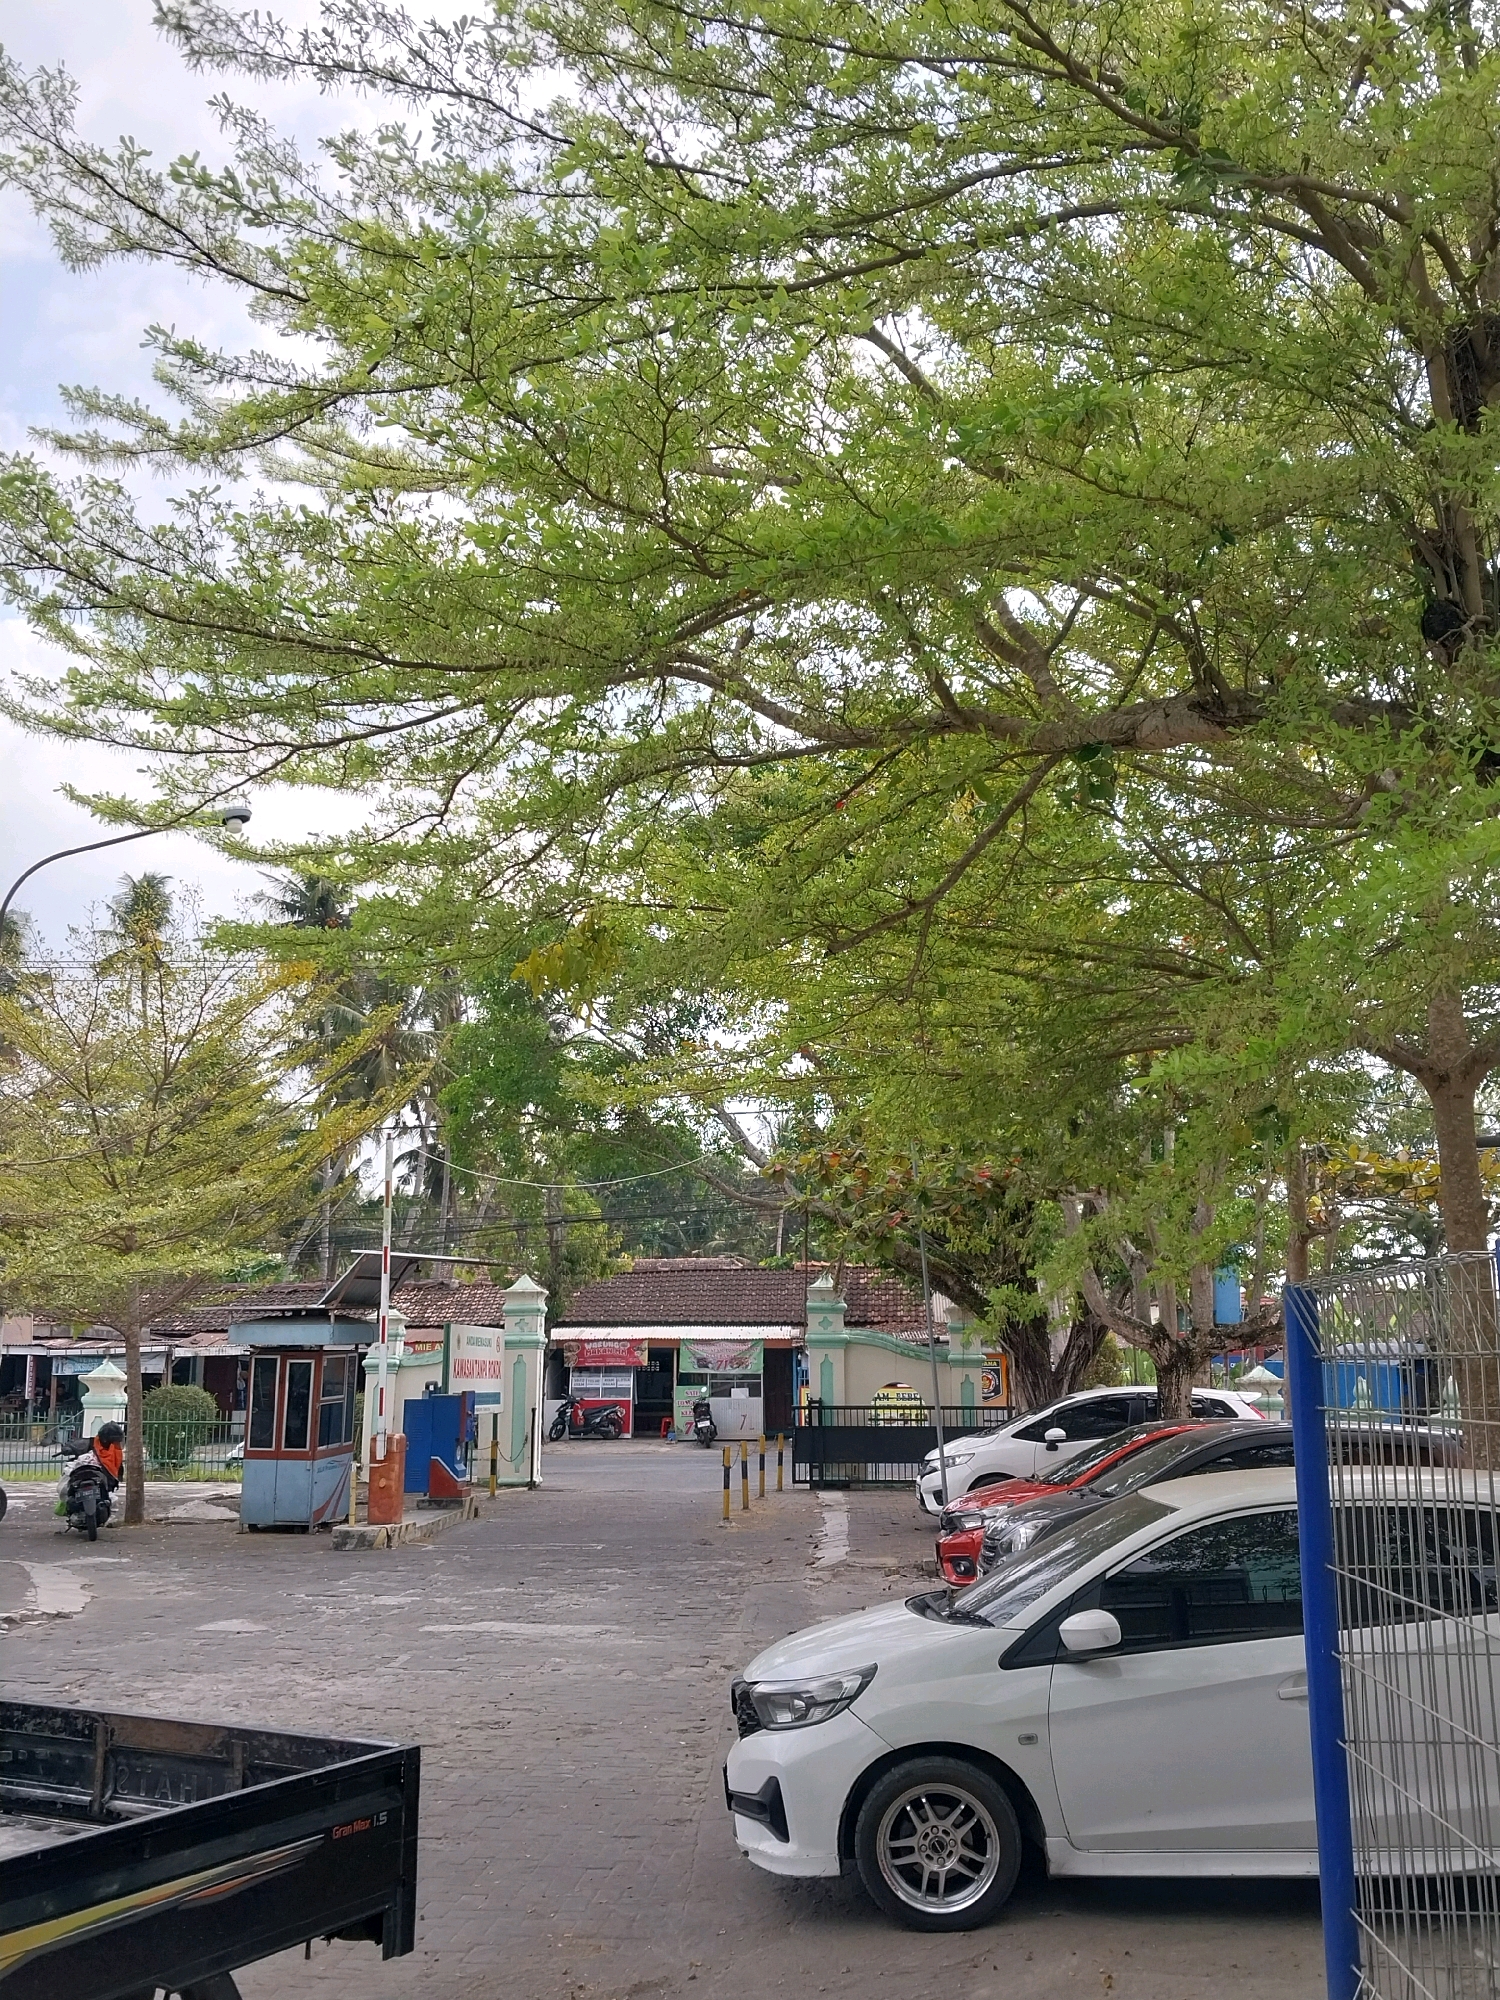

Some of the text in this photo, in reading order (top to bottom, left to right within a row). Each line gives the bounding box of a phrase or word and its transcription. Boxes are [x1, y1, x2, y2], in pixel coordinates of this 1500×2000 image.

[466, 1336, 492, 1348] ANDA MEMASUKI
[585, 1341, 619, 1350] WARUNG
[585, 1348, 612, 1357] MAKAN
[453, 1358, 502, 1380] KAWASAN TANPA ROKOK
[332, 1811, 388, 1840] Gran Max 1.5
